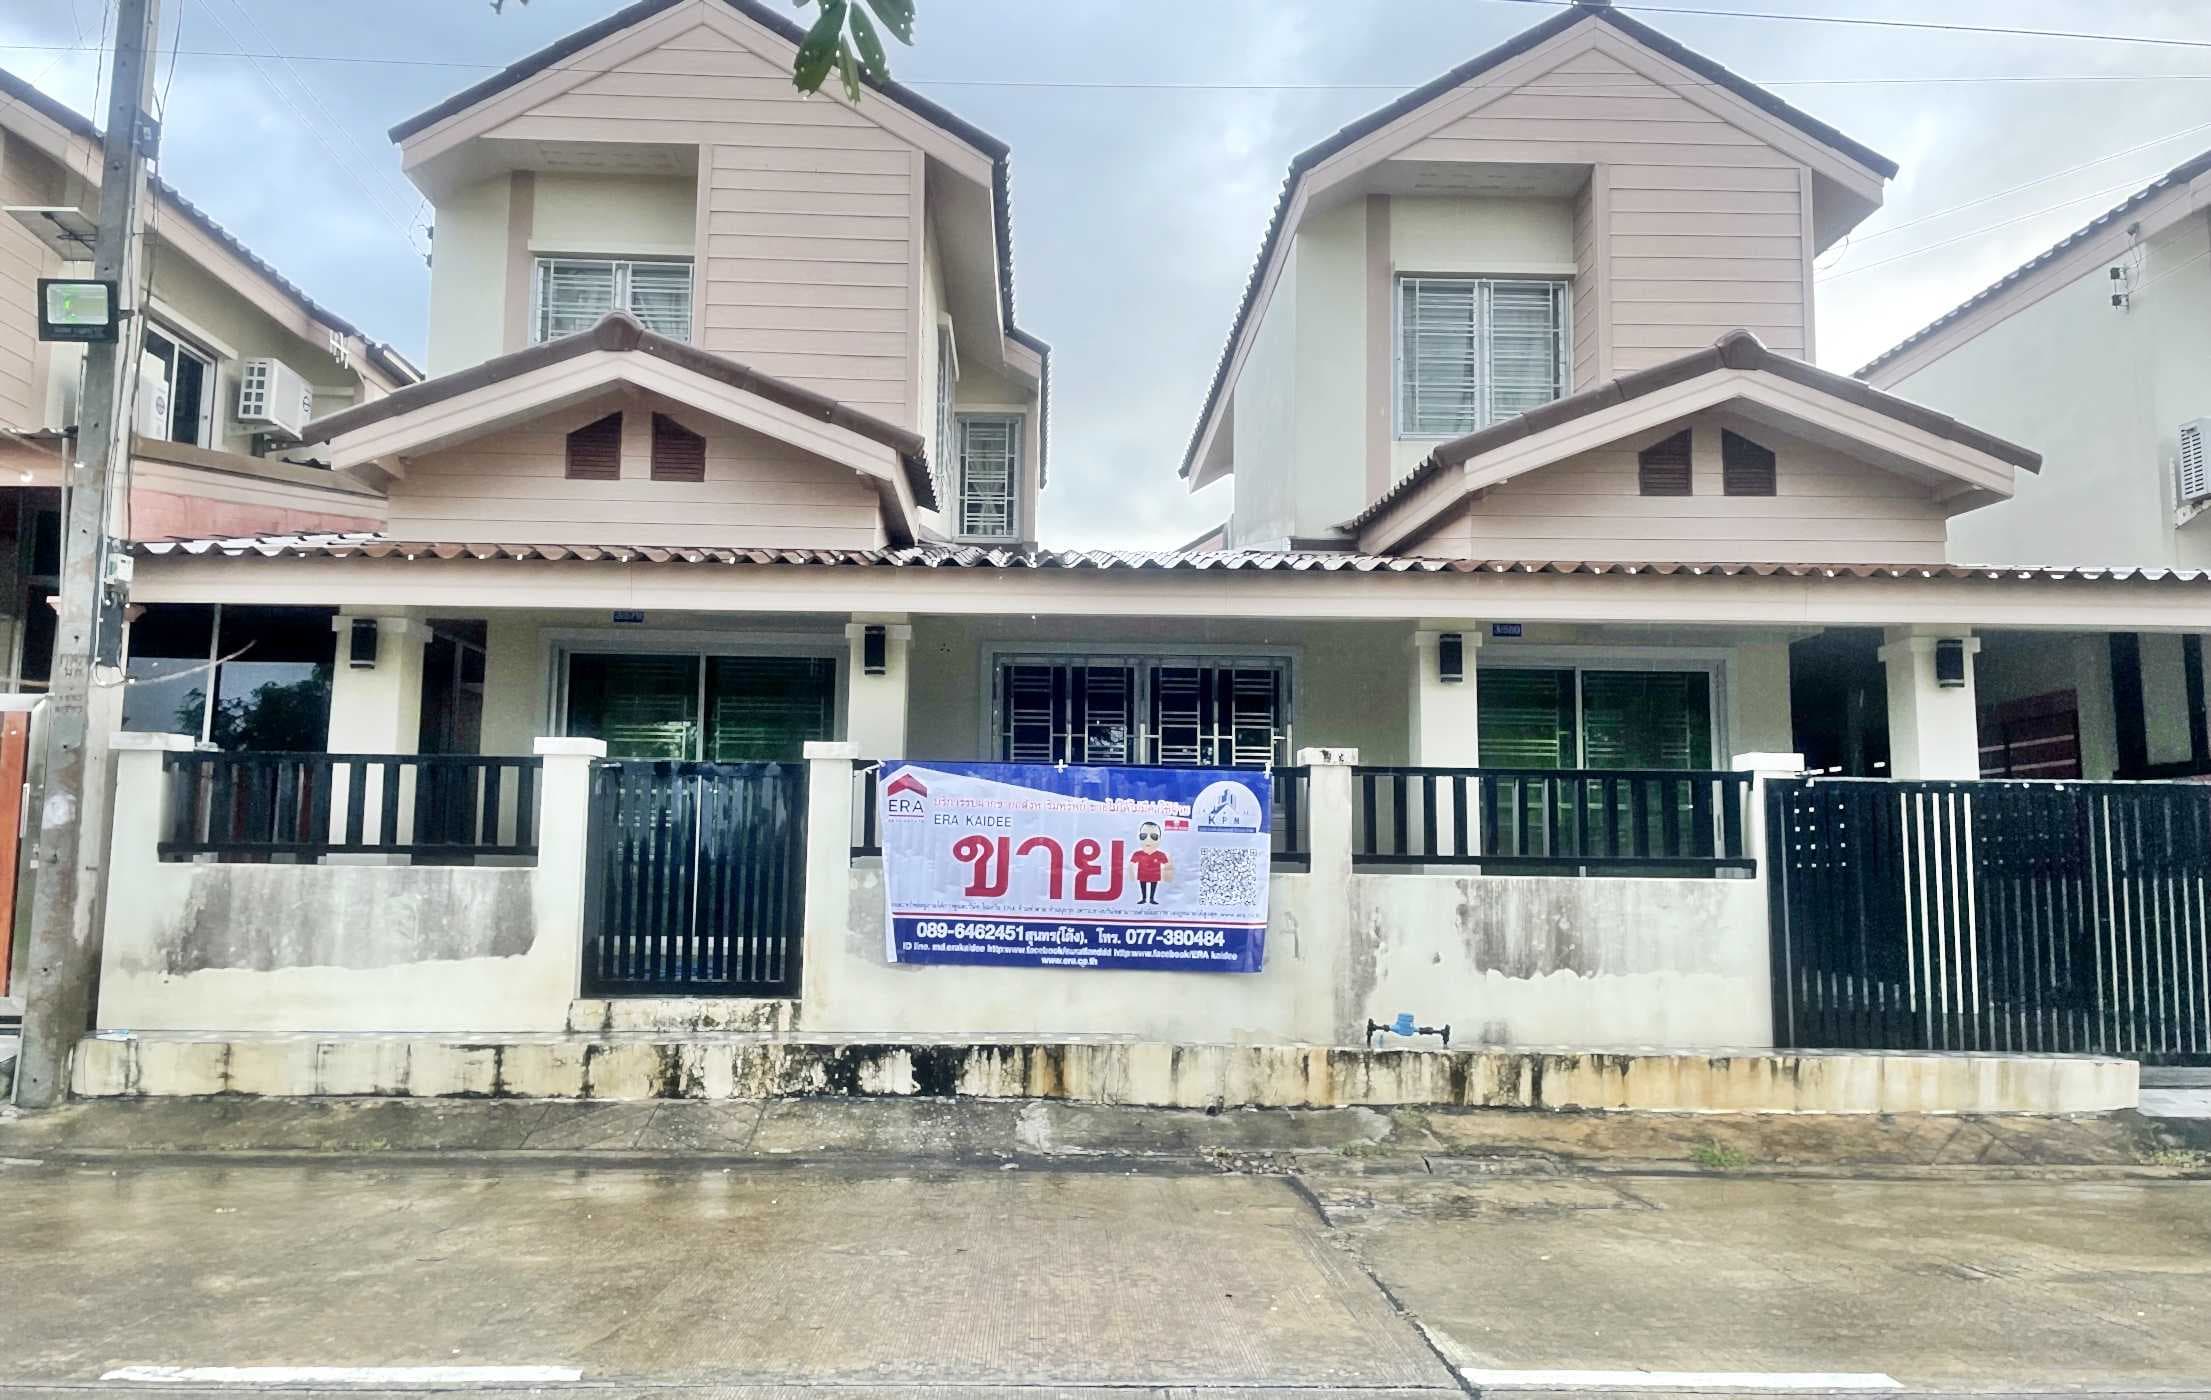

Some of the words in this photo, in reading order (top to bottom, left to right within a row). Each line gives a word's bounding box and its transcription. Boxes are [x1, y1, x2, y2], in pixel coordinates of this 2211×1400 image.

[888, 799, 924, 812] ERA
[934, 814, 959, 826] ERA
[966, 815, 1012, 828] KAIDEE
[952, 833, 1125, 902] ขาย
[916, 921, 1025, 942] 089-6462451
[1125, 928, 1226, 948] 077-380484
[902, 941, 913, 951] ID
